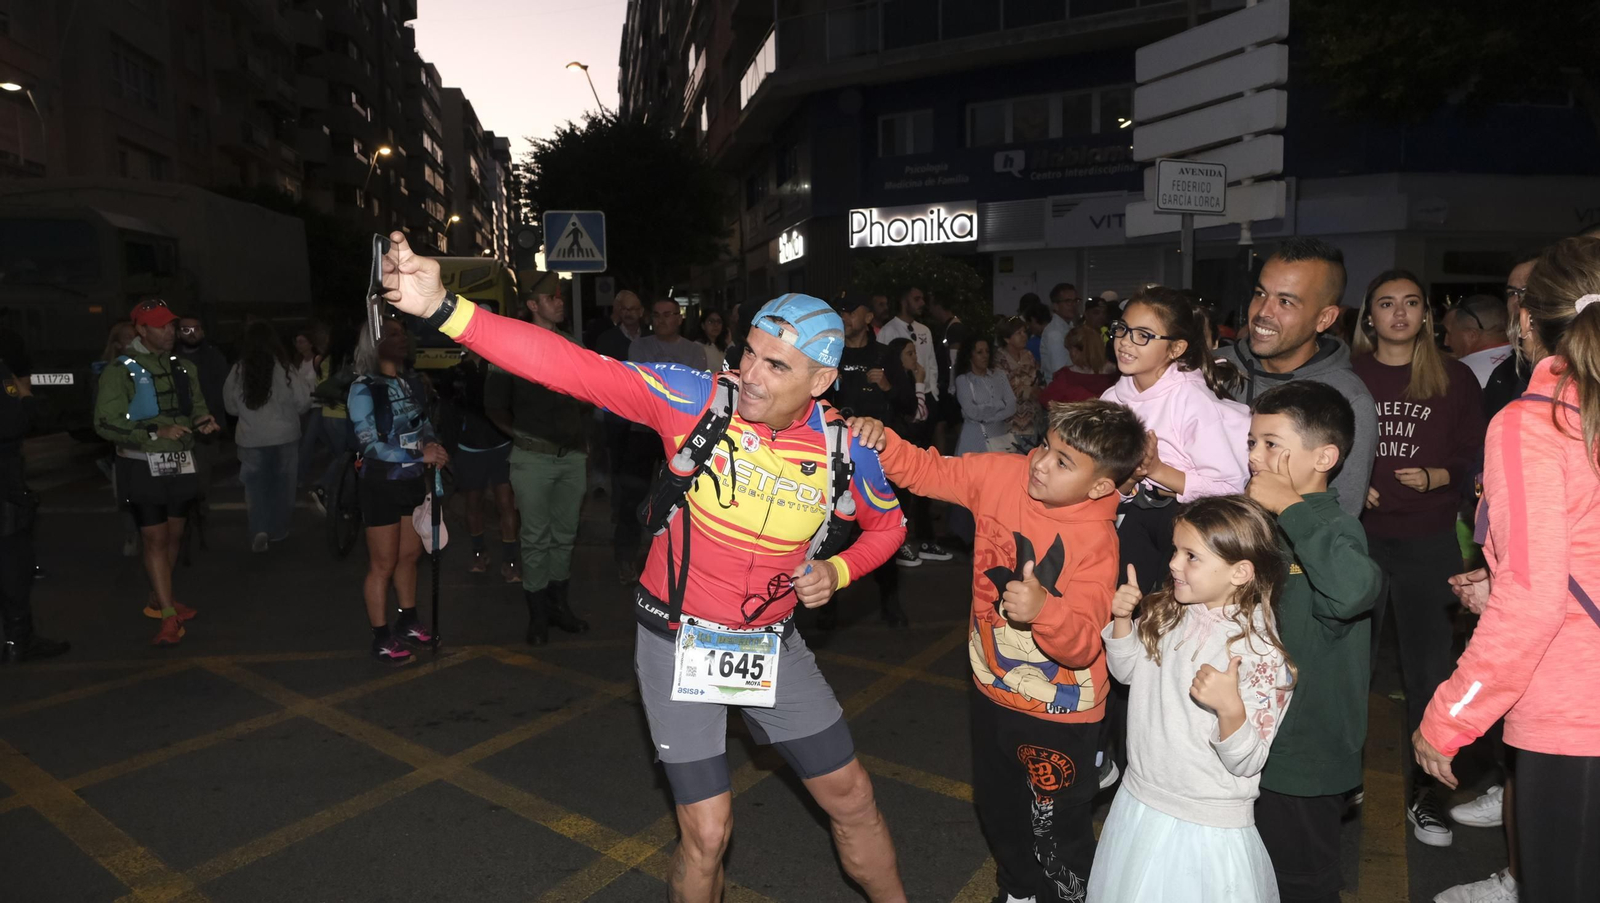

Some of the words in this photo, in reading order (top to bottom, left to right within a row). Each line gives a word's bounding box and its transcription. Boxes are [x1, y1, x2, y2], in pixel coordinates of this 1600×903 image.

[1030, 169, 1062, 181] Centro
[1178, 167, 1223, 178] AVENIDA
[884, 179, 923, 190] Medicina
[925, 178, 937, 187] de
[938, 173, 970, 186] Familia
[1172, 180, 1211, 194] FEDERICO
[1162, 192, 1192, 206] GARCÍA
[1194, 194, 1220, 208] LORCA
[850, 208, 974, 246] Phonika
[36, 374, 71, 384] 111779
[1378, 421, 1415, 438] THAN
[160, 451, 187, 463] 1499
[1376, 442, 1420, 459] ONEY
[704, 650, 765, 681] 1645
[1050, 753, 1073, 778] BALL
